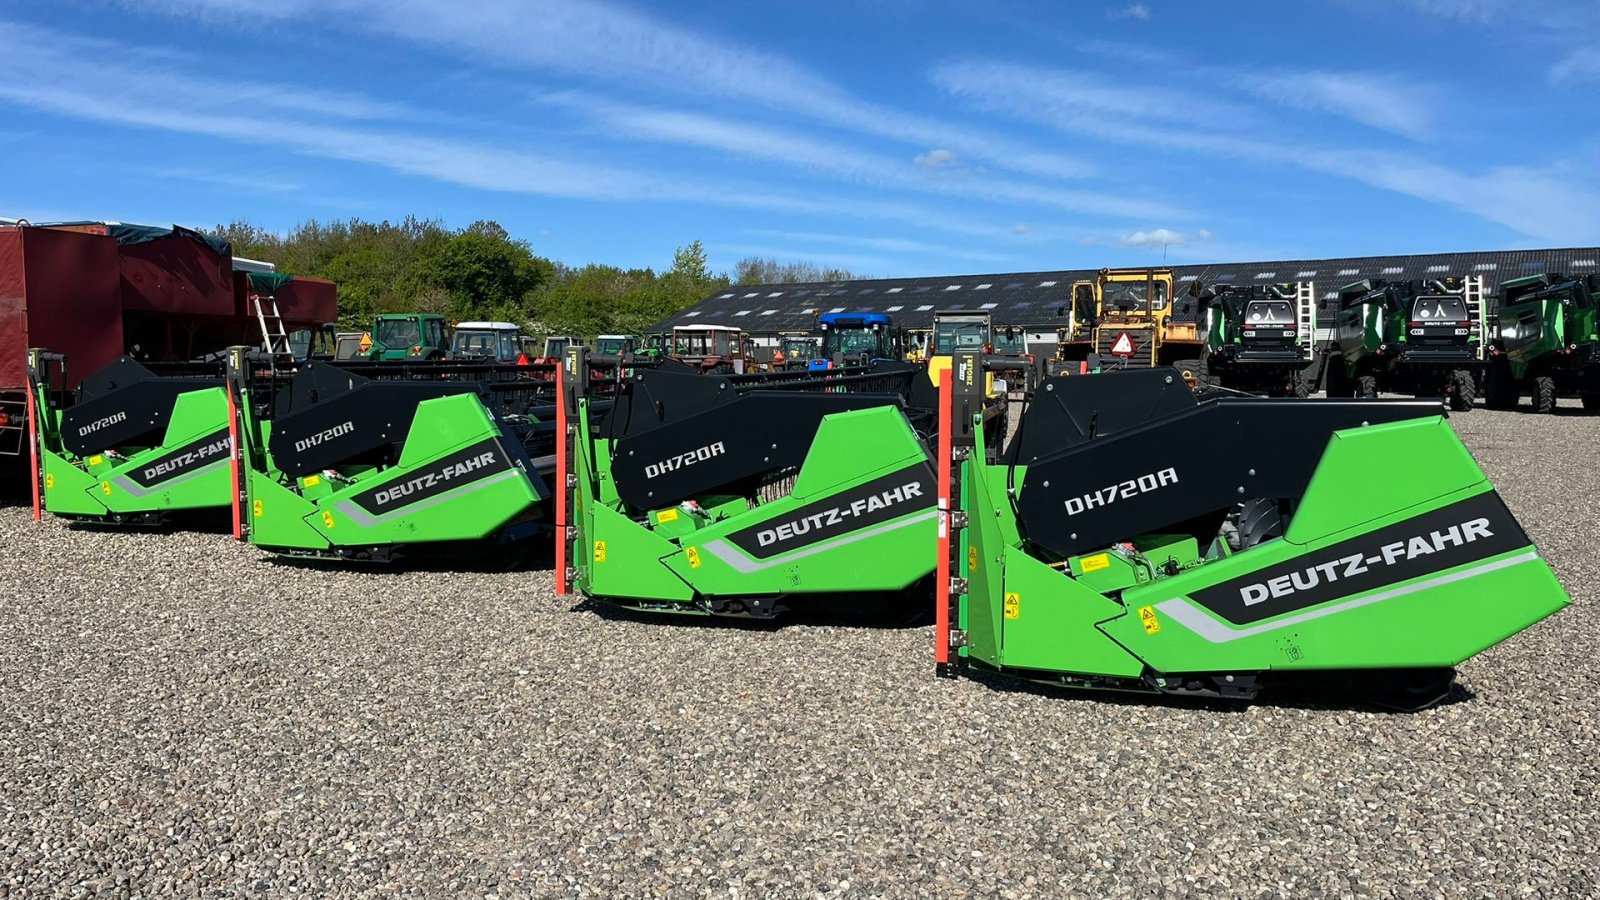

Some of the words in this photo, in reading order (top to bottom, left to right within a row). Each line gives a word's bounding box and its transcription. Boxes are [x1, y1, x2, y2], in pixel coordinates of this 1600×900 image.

[78, 411, 127, 437] DH720A
[294, 420, 355, 453] DH720A
[143, 437, 231, 481] DEUTZ-FAH
[374, 451, 497, 506] DEUTZ-FAHR
[644, 441, 726, 479] DH720A
[756, 481, 924, 547] DEUTZ-FAHR
[1064, 466, 1180, 516] DH720A
[1239, 517, 1495, 607] DEUTZ-FAHR
